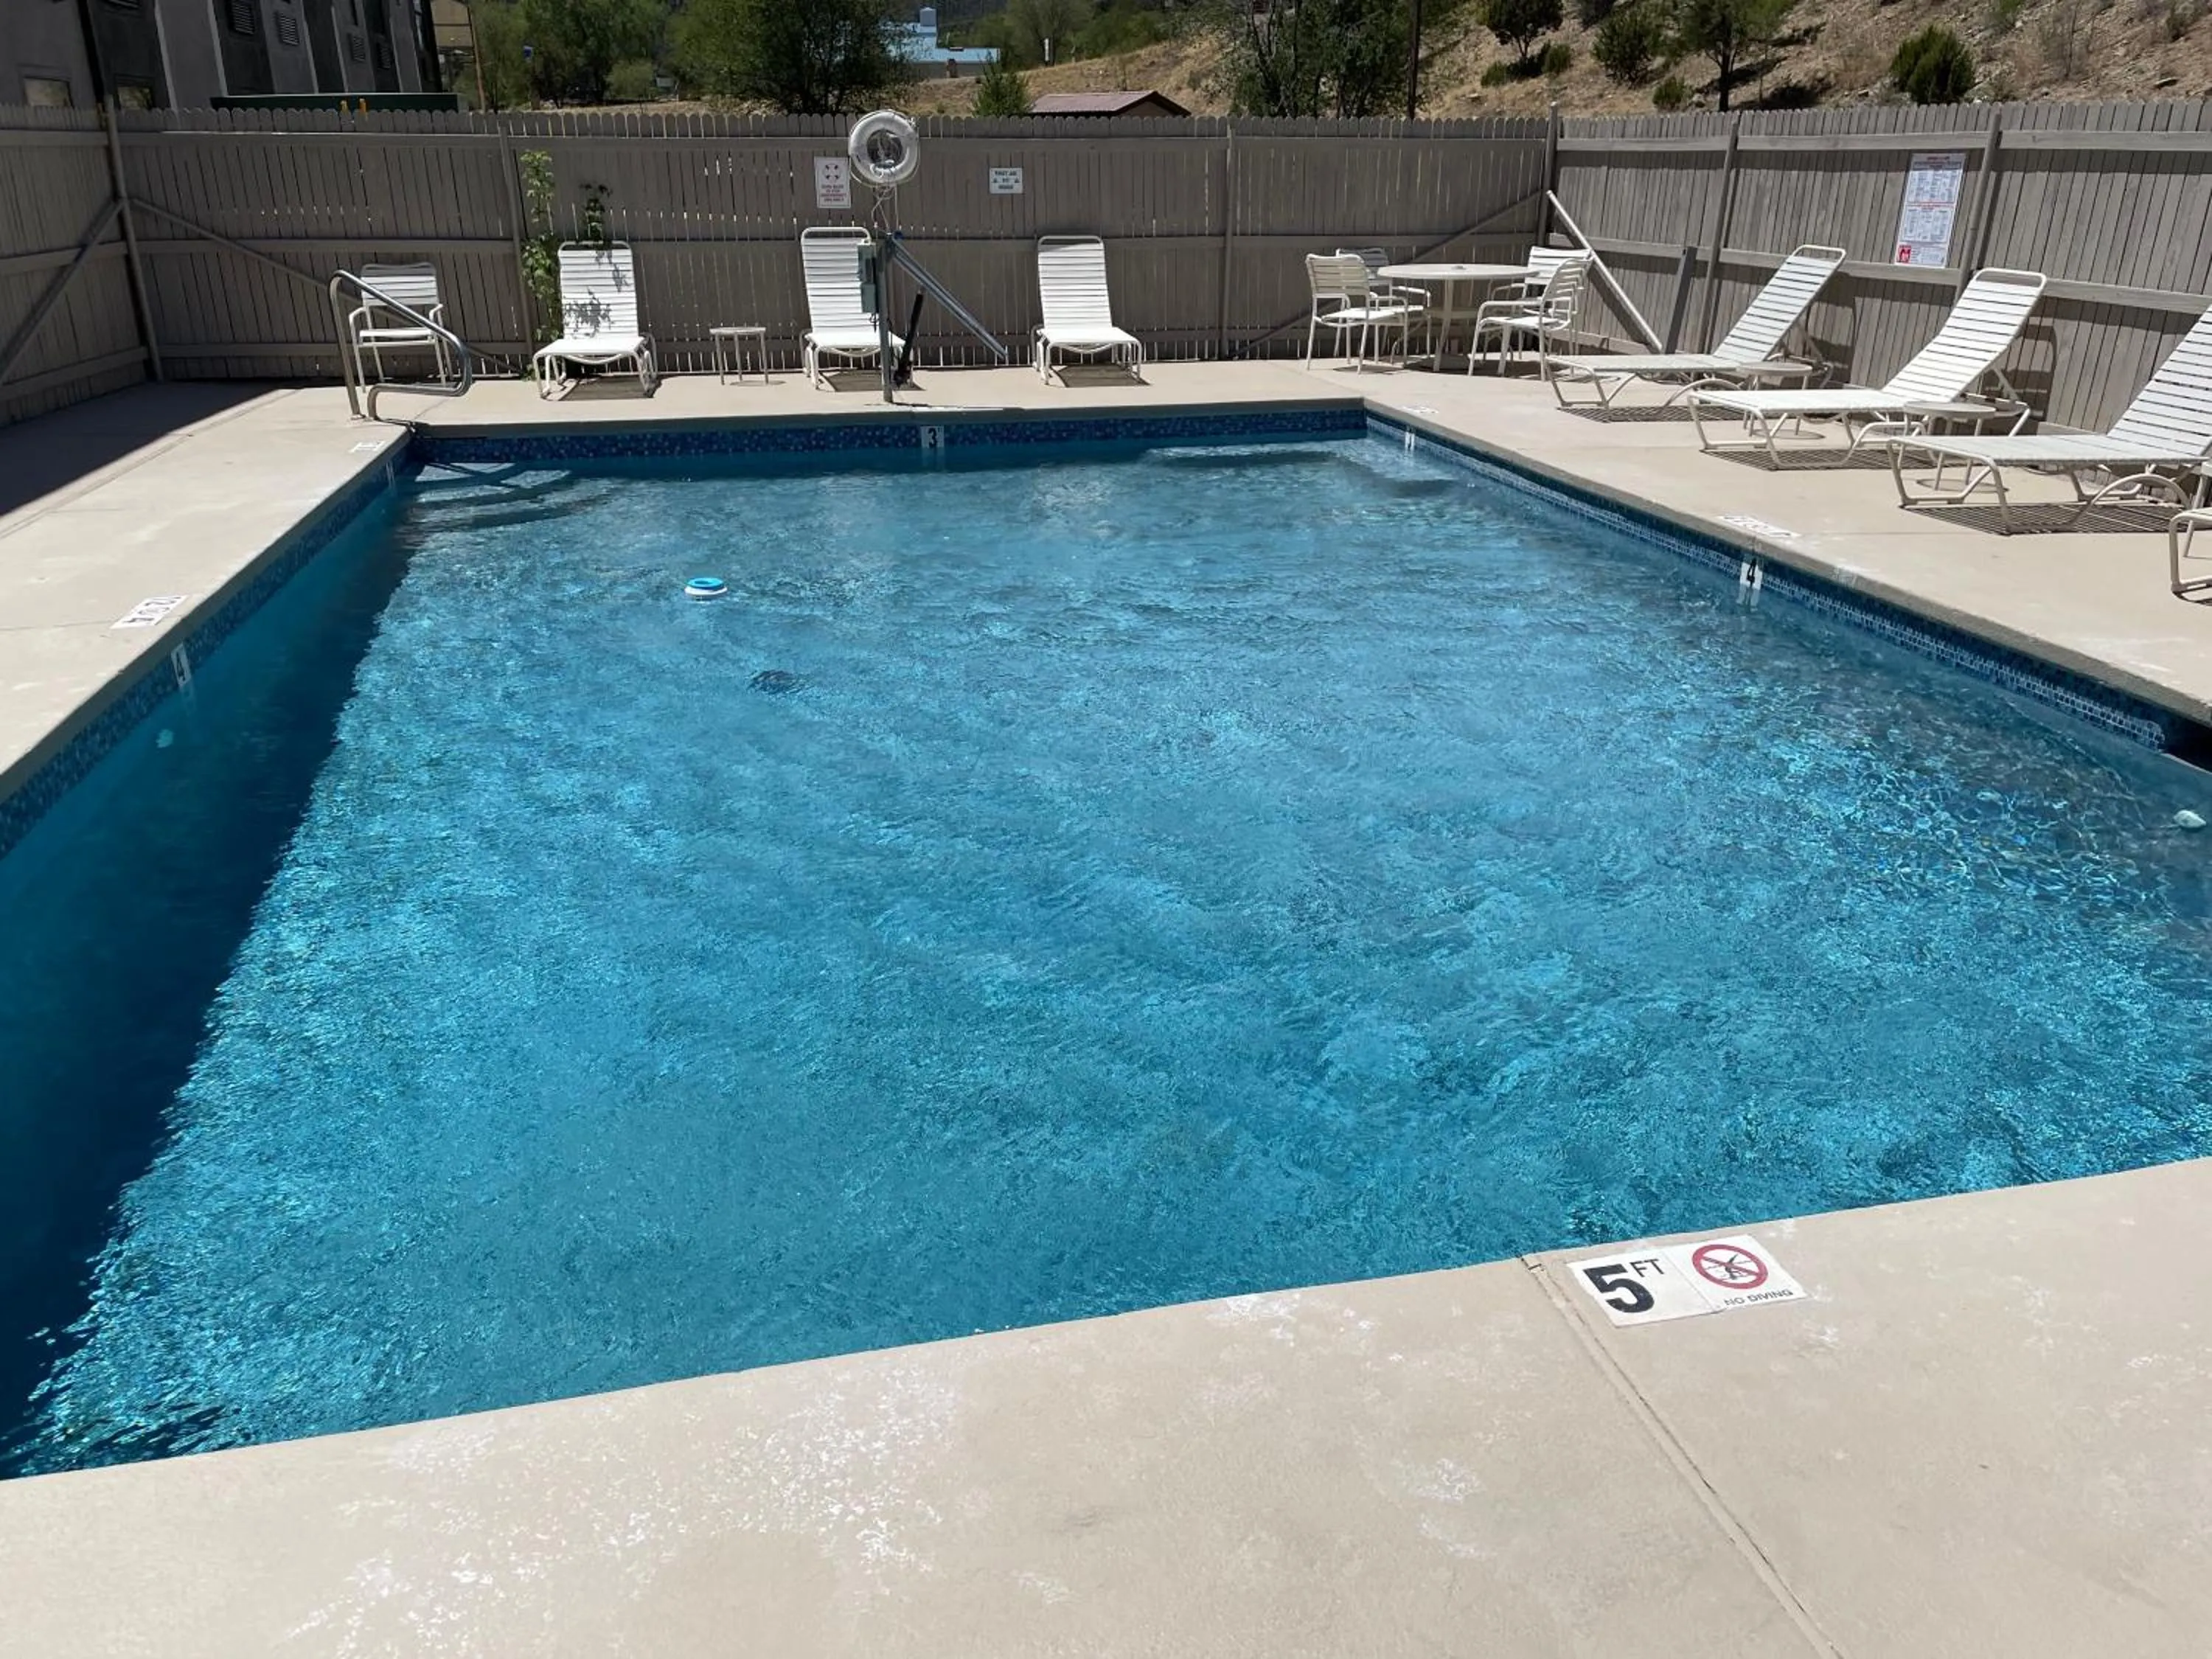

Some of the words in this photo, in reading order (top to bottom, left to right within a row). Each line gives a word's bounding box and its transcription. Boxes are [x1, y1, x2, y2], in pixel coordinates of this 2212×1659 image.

[927, 427, 937, 447] 3
[1745, 558, 1756, 588] 4
[1583, 1263, 1655, 1313] 5
[1630, 1259, 1664, 1278] FT
[1724, 1297, 1745, 1306] NO
[1747, 1288, 1794, 1303] DIVING
